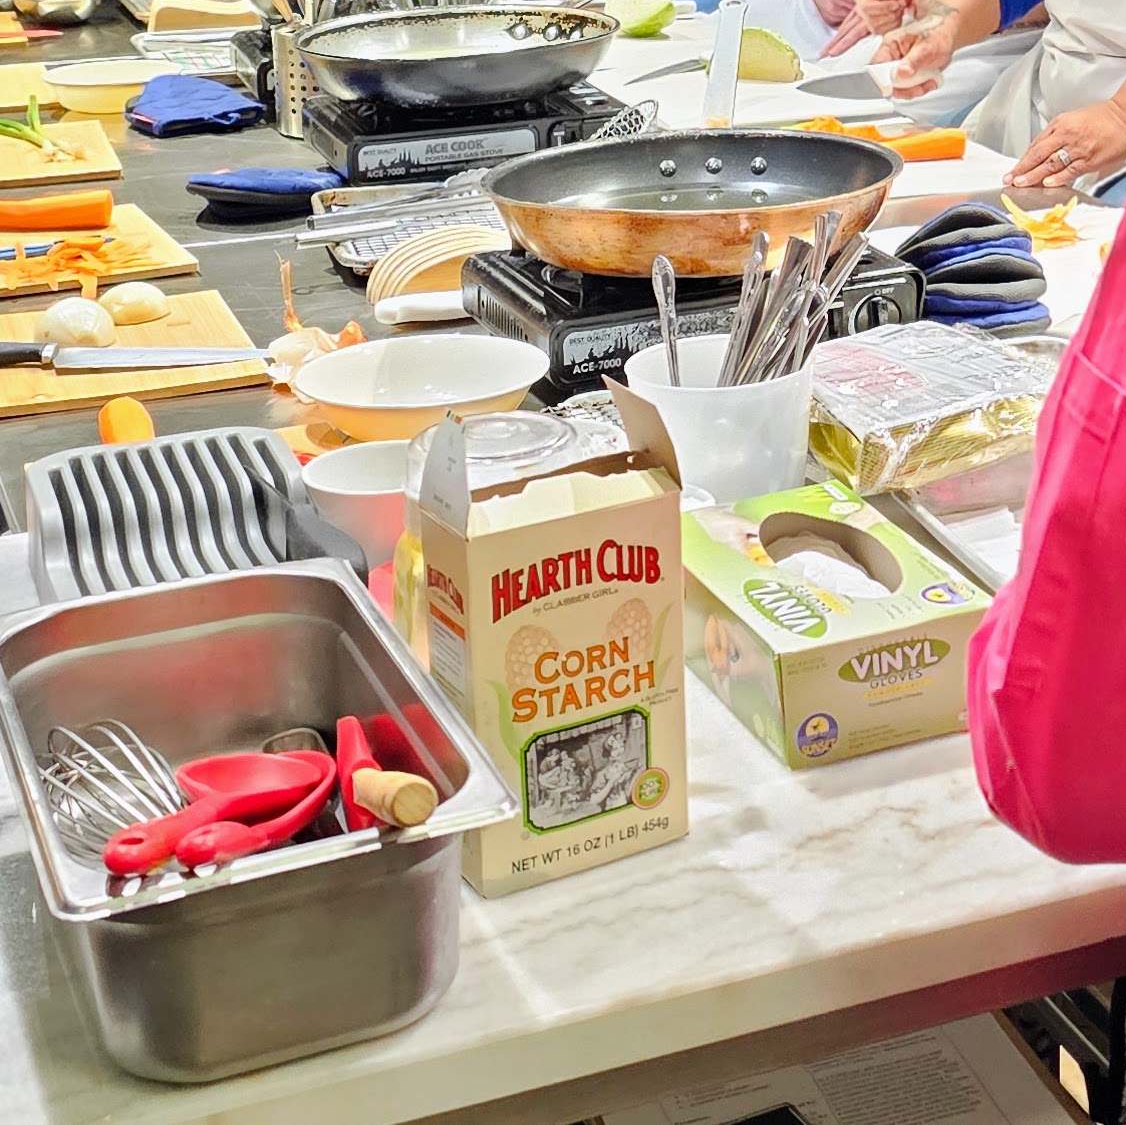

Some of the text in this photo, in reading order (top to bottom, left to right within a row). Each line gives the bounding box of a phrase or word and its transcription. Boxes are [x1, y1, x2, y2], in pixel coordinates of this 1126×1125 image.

[425, 138, 485, 155] ACE COOK
[425, 153, 462, 162] PORTABLE
[367, 167, 406, 179] ACE-7000
[573, 358, 622, 374] ACE-7000
[491, 548, 593, 624] HEARTH
[597, 539, 661, 584] CLUB
[592, 587, 615, 600] GIRL
[748, 581, 821, 634] VINYL
[534, 636, 630, 684] CORN
[850, 640, 939, 680] VINYL
[512, 660, 655, 723] STARCH
[869, 668, 923, 689] GLOVES
[511, 856, 538, 874] NET
[541, 848, 562, 865] WT
[567, 843, 580, 858] 16
[584, 837, 602, 851] OZ
[619, 824, 639, 842] LB)
[642, 816, 669, 833] 454g
